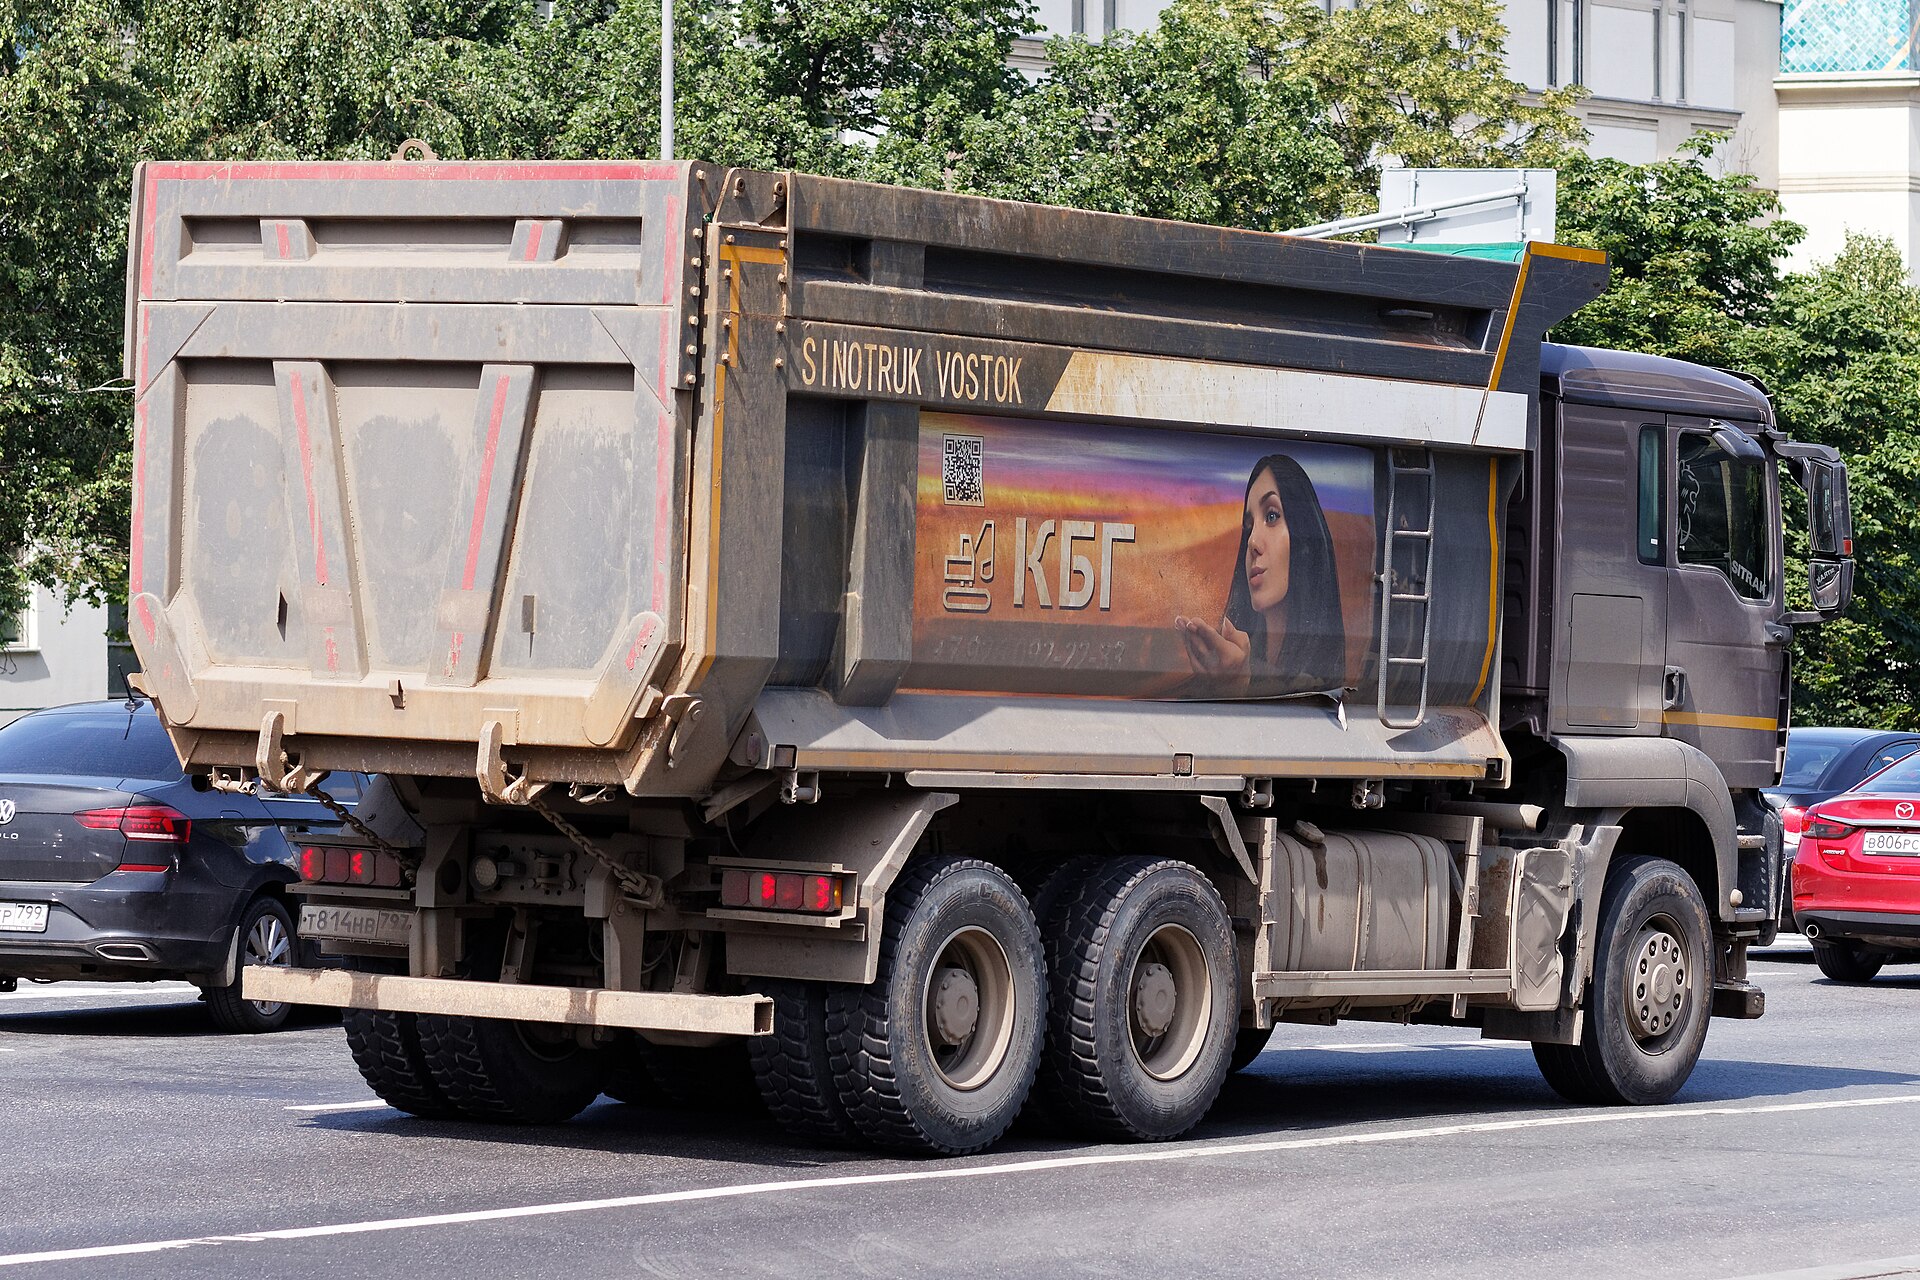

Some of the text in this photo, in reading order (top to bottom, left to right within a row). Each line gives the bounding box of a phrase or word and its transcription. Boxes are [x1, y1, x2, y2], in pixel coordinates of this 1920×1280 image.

[801, 336, 1023, 404] SINOTRUK VOSTOK
[1013, 516, 1136, 611] КБГ
[1731, 560, 1767, 599] SITRAK
[0, 832, 19, 840] LO
[17, 905, 42, 920] 799
